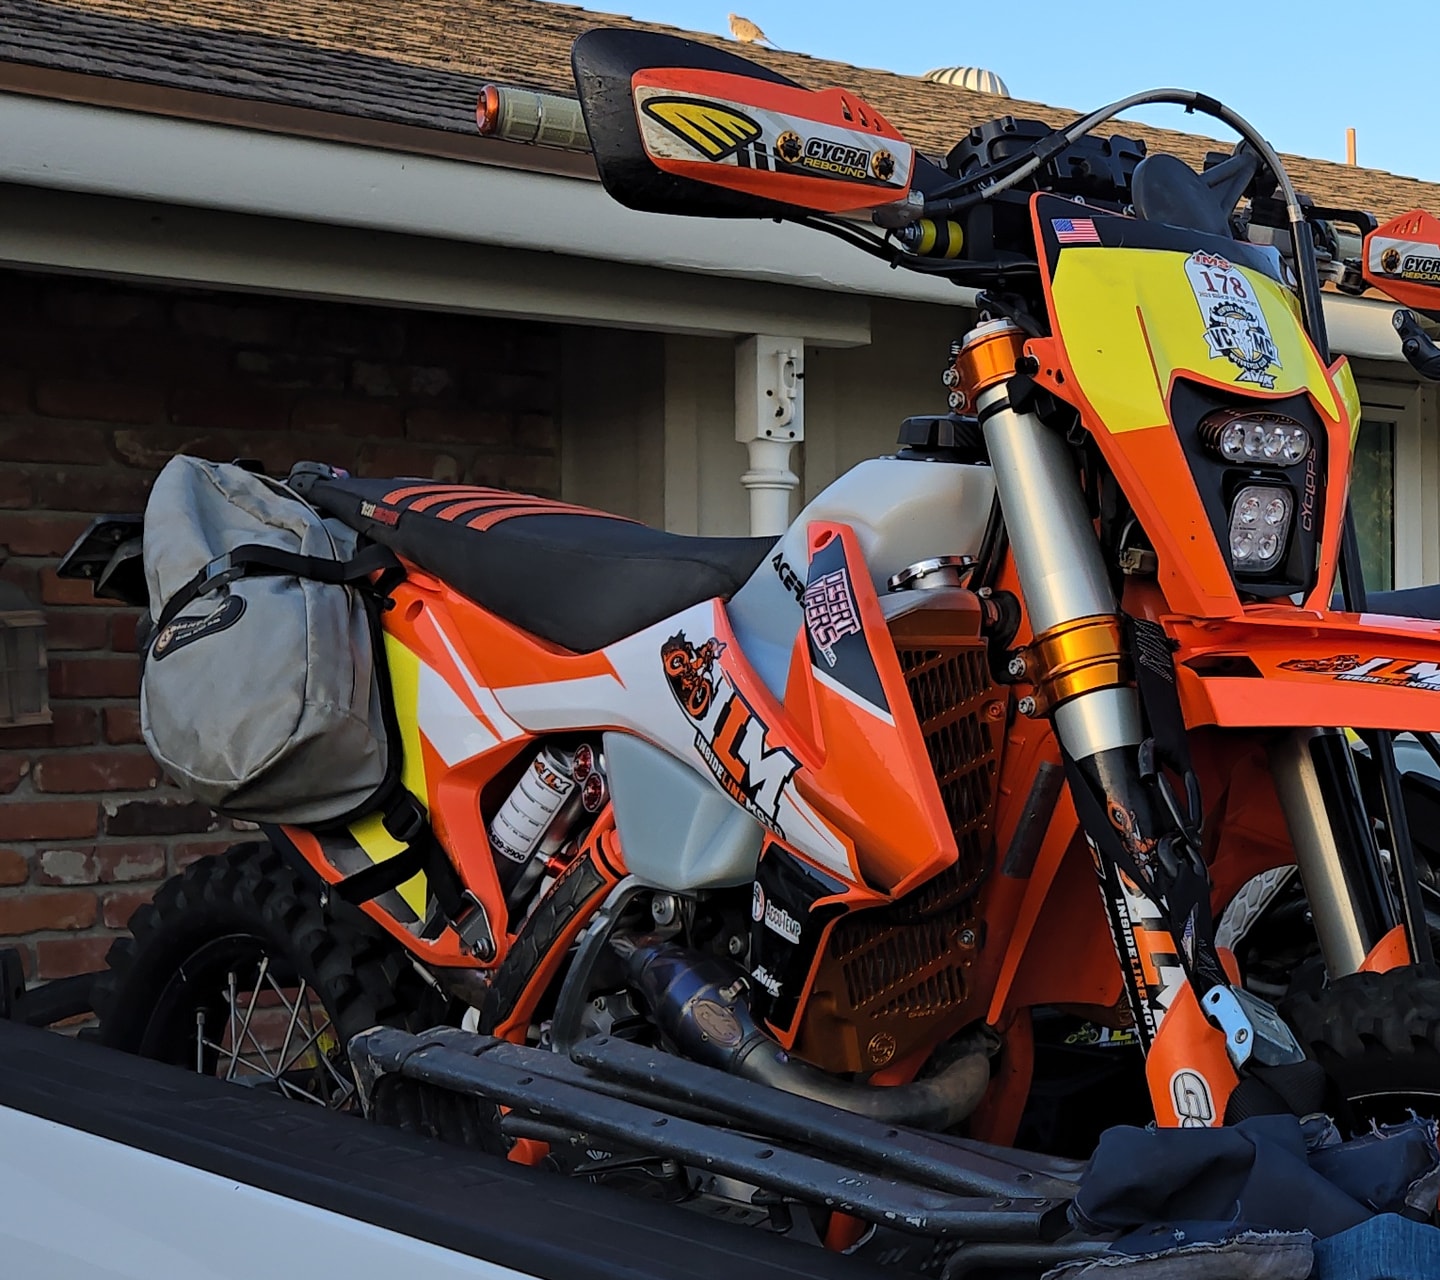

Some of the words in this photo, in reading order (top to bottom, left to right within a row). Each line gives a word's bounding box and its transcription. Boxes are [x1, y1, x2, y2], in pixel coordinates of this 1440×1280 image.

[803, 157, 867, 179] REBOUND
[806, 140, 868, 169] CYCRA
[1194, 254, 1231, 270] IMS
[1200, 271, 1247, 299] 178
[1213, 329, 1233, 348] VC
[1252, 334, 1275, 357] MC
[1301, 448, 1317, 532] CYCLOPS
[804, 575, 838, 648] VIPERS
[824, 568, 860, 634] DESERT
[697, 677, 799, 818] ILM
[696, 733, 784, 840] INSIDELINEMOTO
